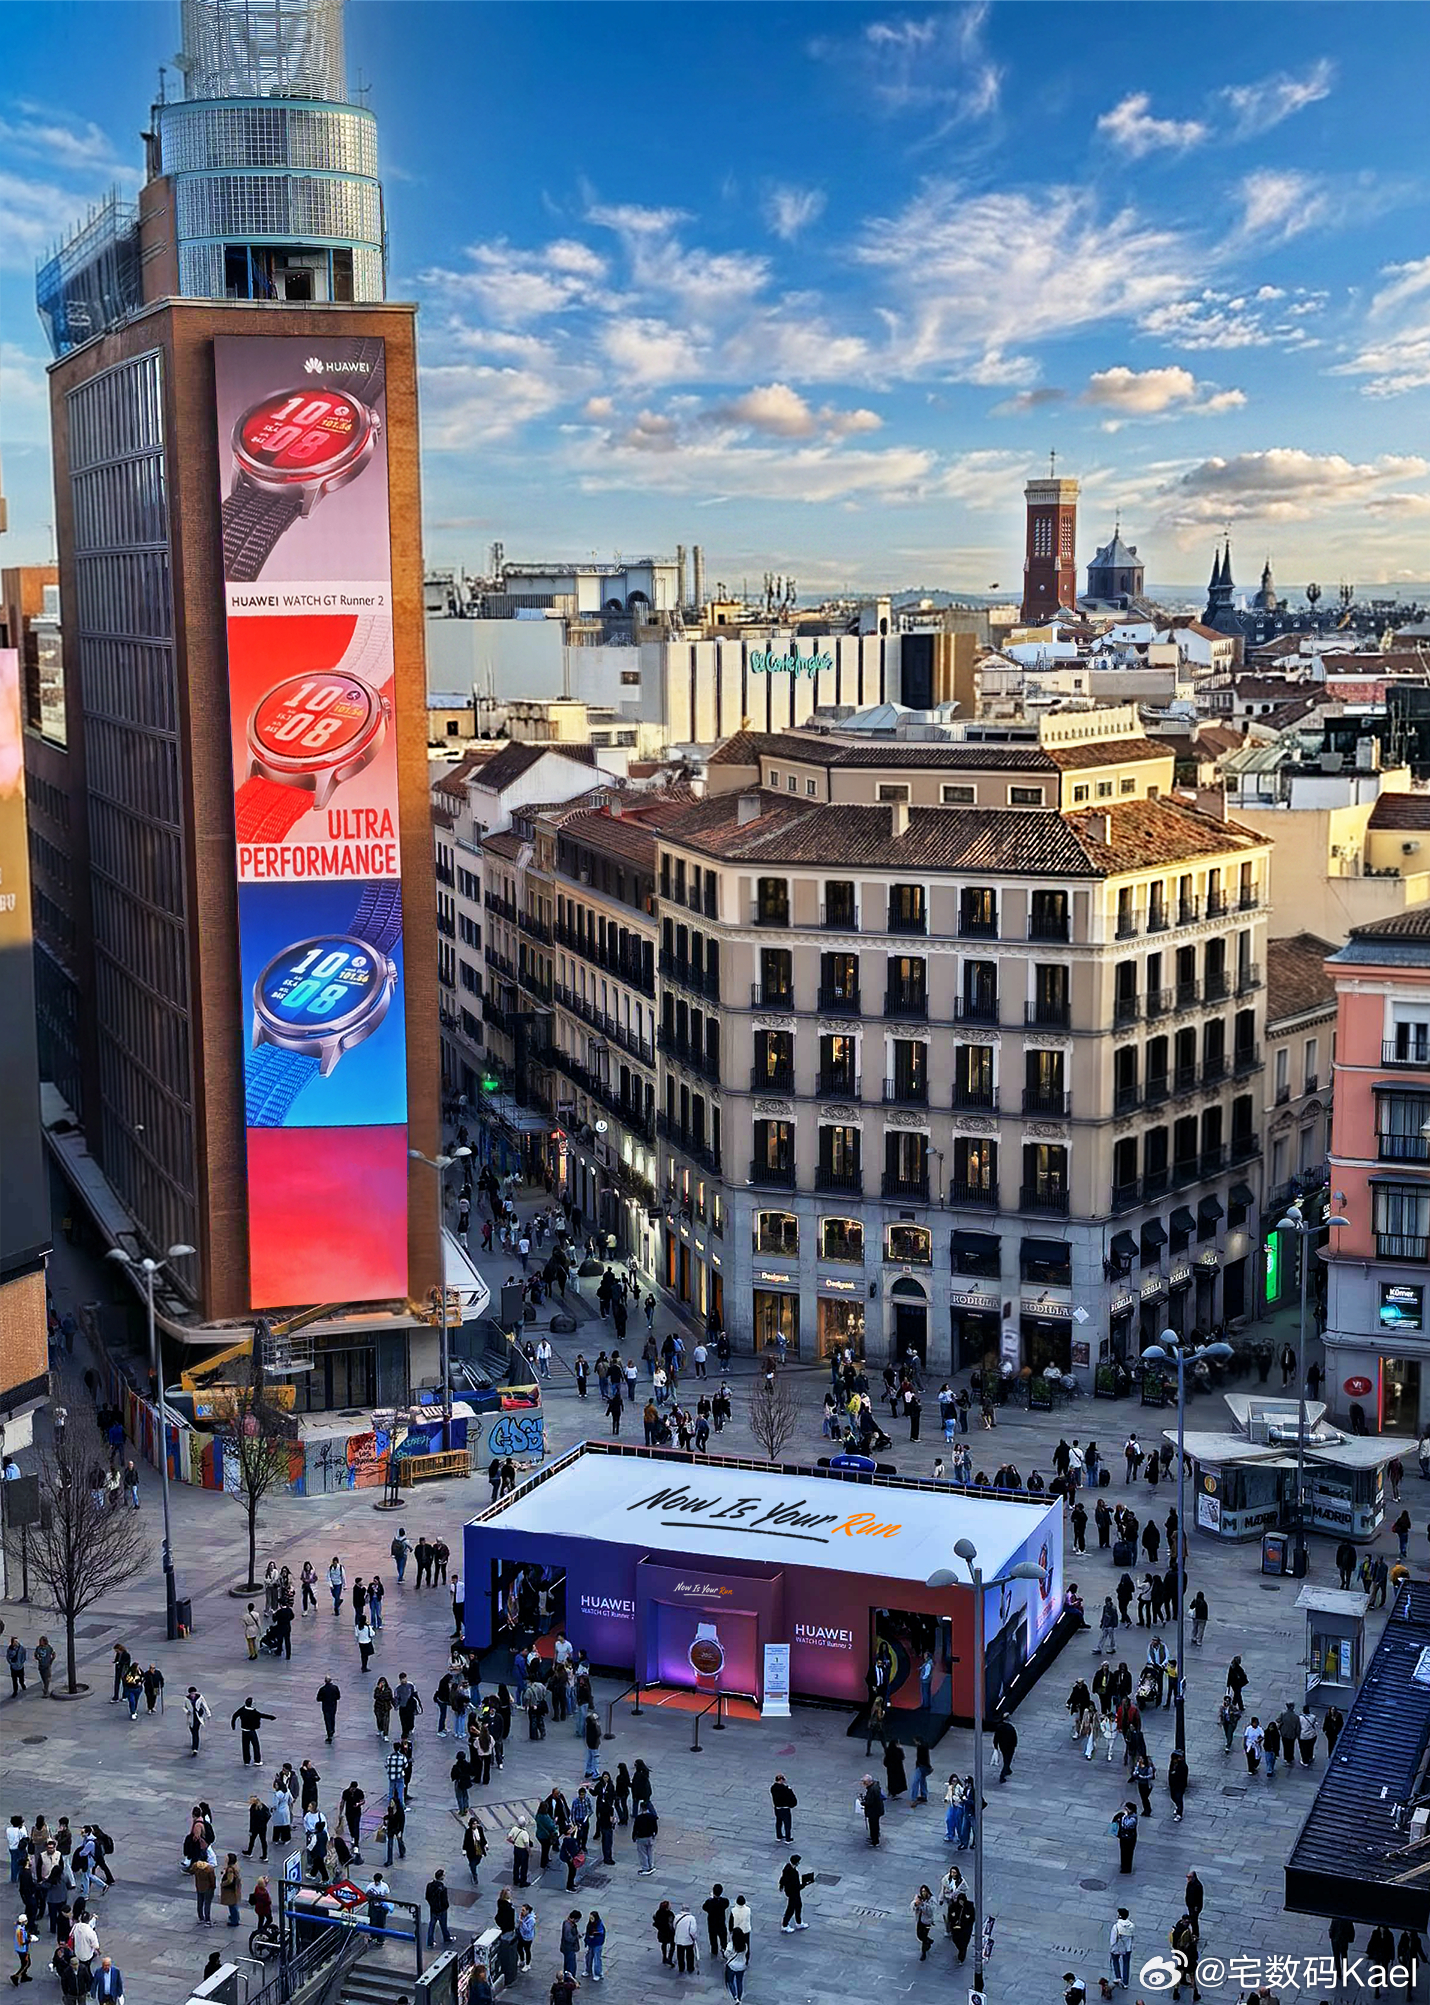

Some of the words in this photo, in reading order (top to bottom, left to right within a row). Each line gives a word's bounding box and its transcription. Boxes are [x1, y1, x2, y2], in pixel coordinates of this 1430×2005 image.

[326, 362, 370, 373] HUAWEI
[270, 397, 332, 425] 10
[262, 425, 331, 459] 08
[231, 596, 279, 607] HUAWEI
[283, 595, 321, 606] WATCH
[323, 595, 338, 606] GT
[340, 594, 375, 606] Runner
[378, 595, 384, 606] 2
[282, 682, 344, 711] 10
[274, 713, 343, 748] 08
[328, 808, 395, 840] ULTRA
[240, 844, 397, 877] PERFORMANCE
[290, 949, 349, 978] 10
[281, 979, 348, 1014] 08
[952, 1295, 999, 1308] RODILLA
[1022, 1303, 1070, 1316] RODILLA
[627, 1485, 722, 1512] Now
[709, 1498, 761, 1518] Is
[749, 1500, 838, 1528] Your
[831, 1513, 902, 1538] Run
[673, 1581, 692, 1592] Now
[692, 1584, 701, 1592] Is
[701, 1584, 718, 1594] Your
[718, 1586, 734, 1595] Run
[581, 1595, 635, 1612] HUAWEI
[795, 1623, 853, 1642] HUAWEI
[795, 1636, 818, 1645] WATCH
